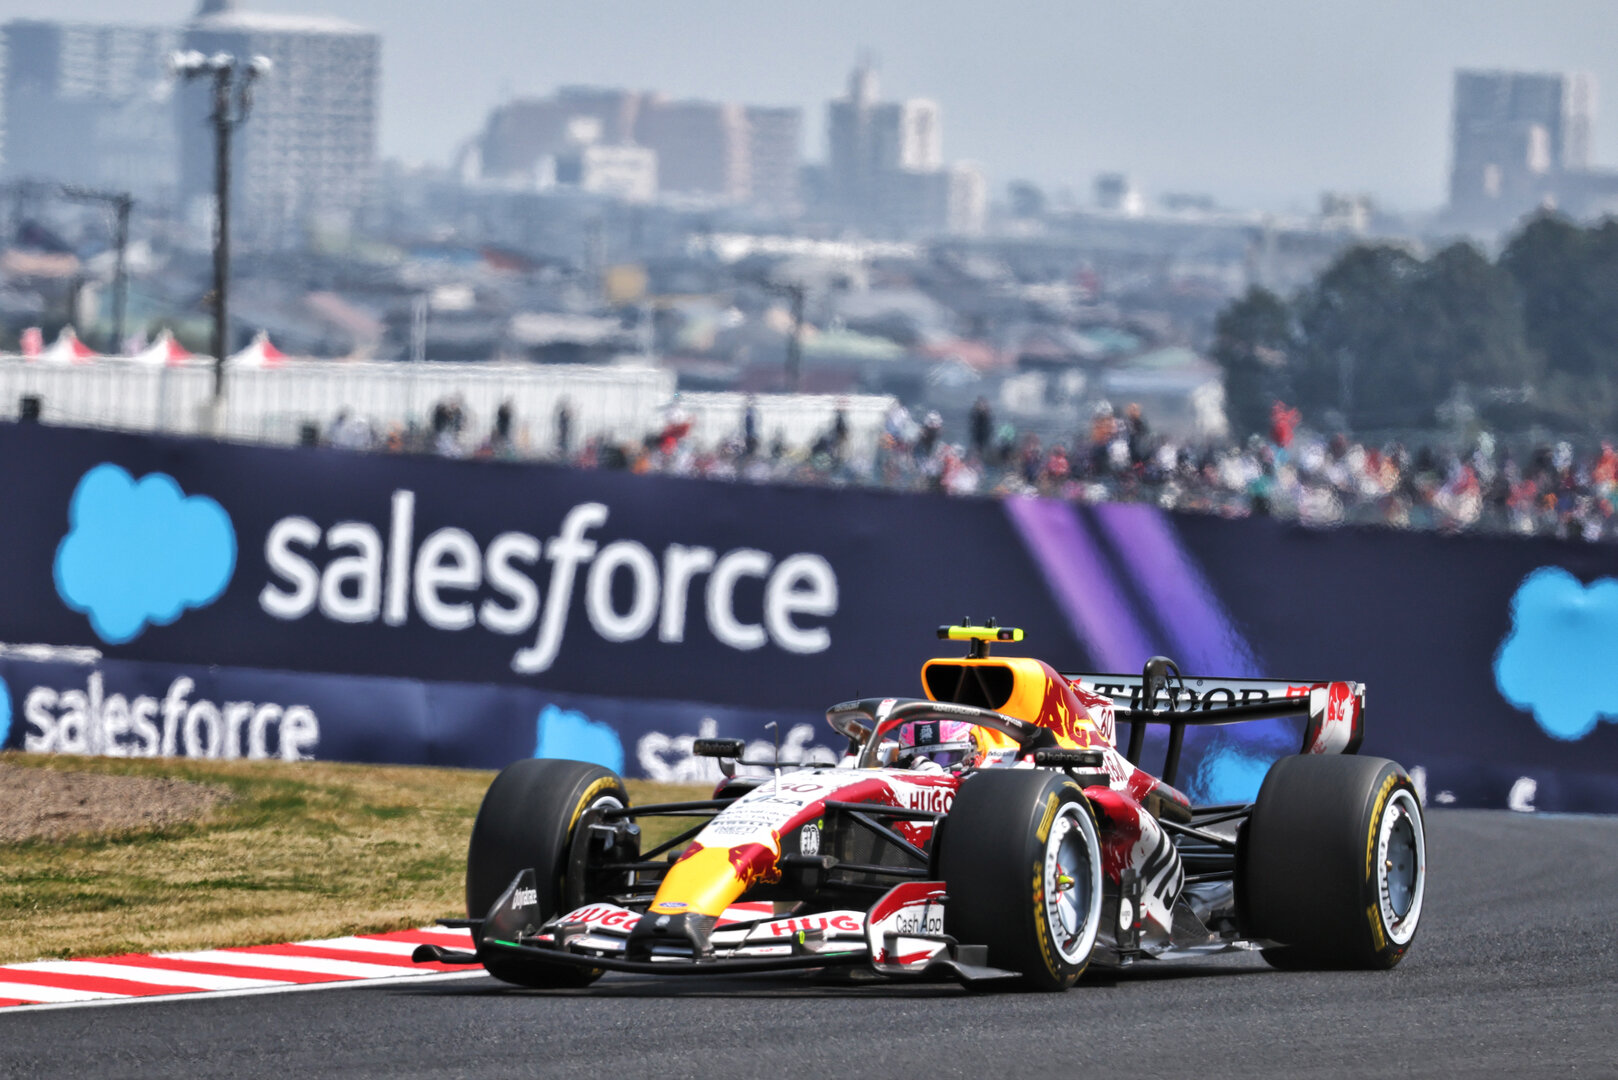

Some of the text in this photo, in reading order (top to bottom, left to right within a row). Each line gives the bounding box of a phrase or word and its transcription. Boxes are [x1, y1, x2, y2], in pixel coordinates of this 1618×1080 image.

[259, 488, 838, 674] salesforce
[24, 671, 319, 761] salesforce
[910, 789, 955, 813] HUGO
[770, 915, 866, 936] HUG
[896, 914, 942, 935] Cash App
